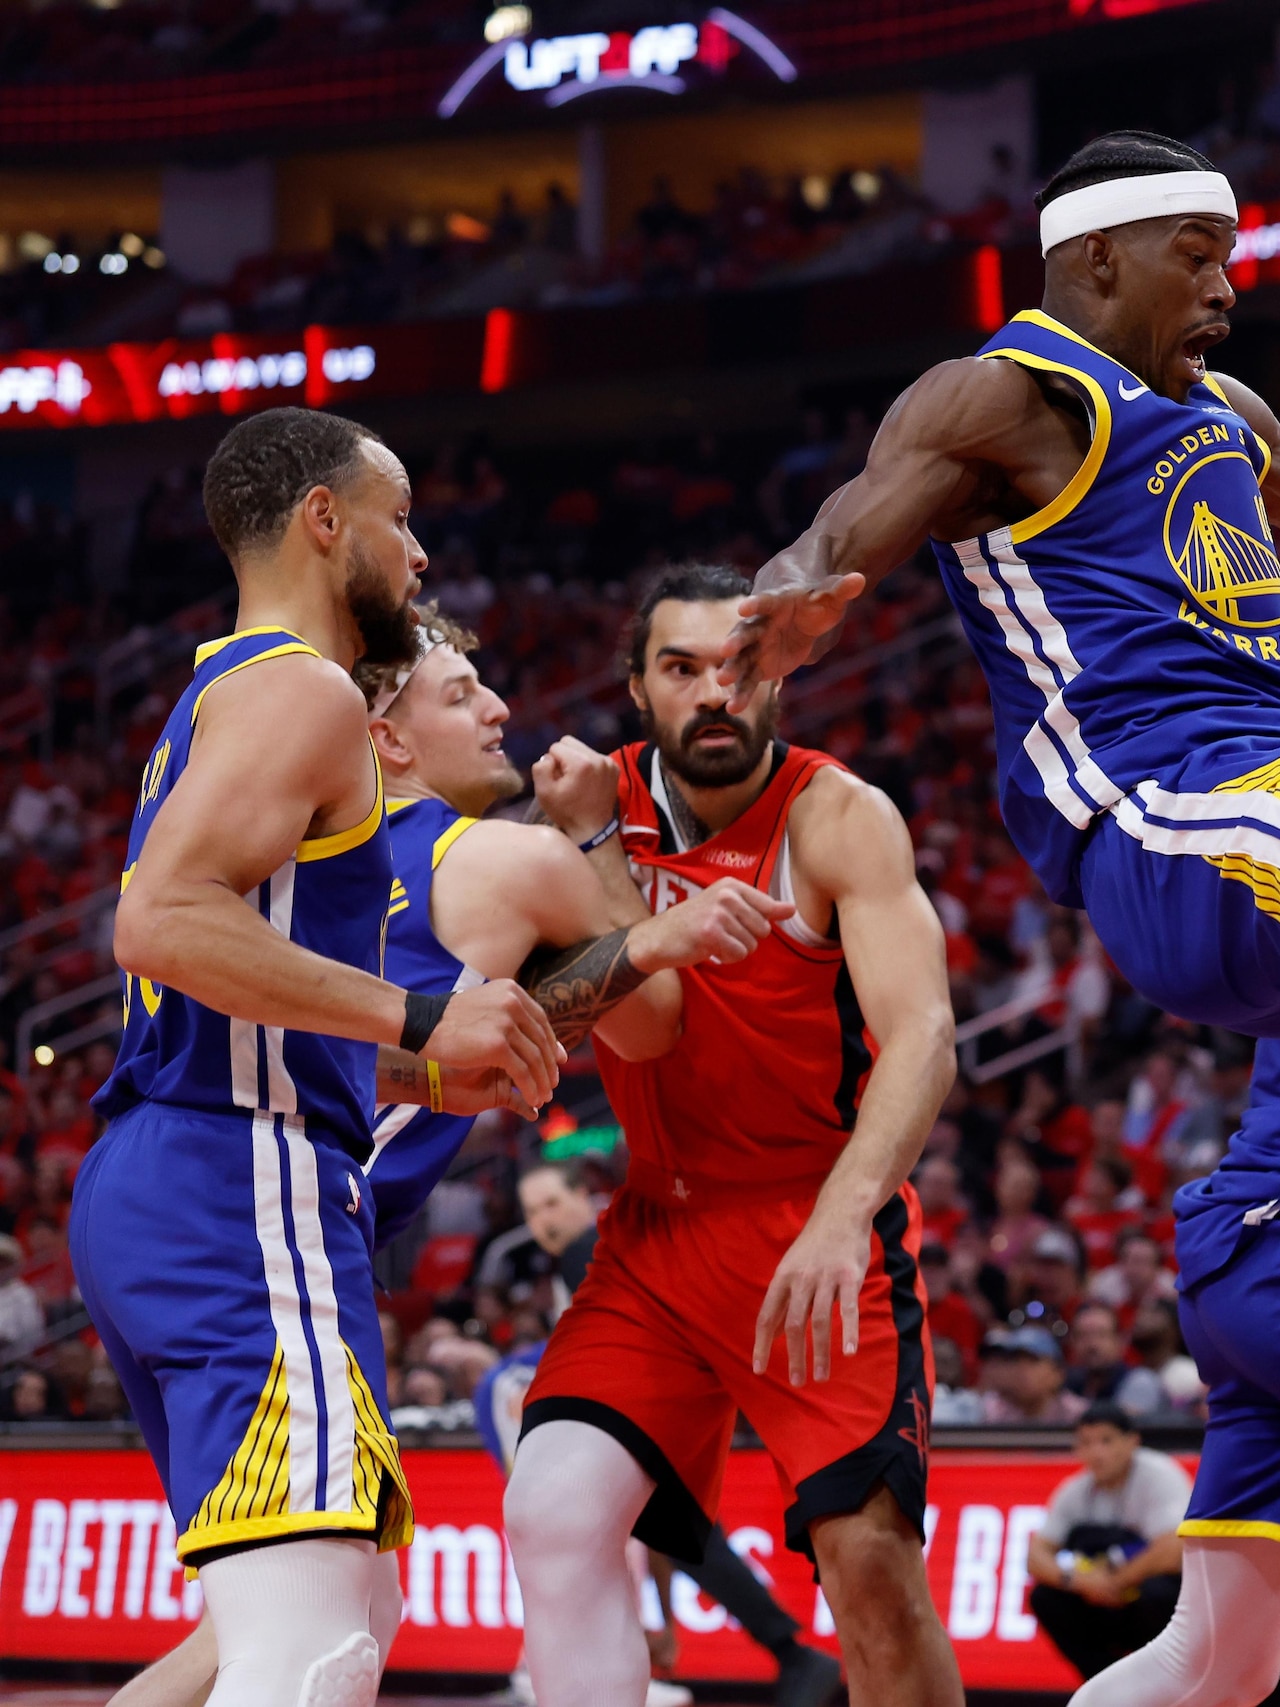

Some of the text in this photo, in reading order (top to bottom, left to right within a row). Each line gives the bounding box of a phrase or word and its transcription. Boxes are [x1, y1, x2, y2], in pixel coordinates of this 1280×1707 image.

[504, 23, 698, 90] LIFTOFF
[158, 345, 375, 397] ALWAYS US
[1146, 424, 1230, 495] GOLDEN
[23, 1499, 202, 1621] BETTE
